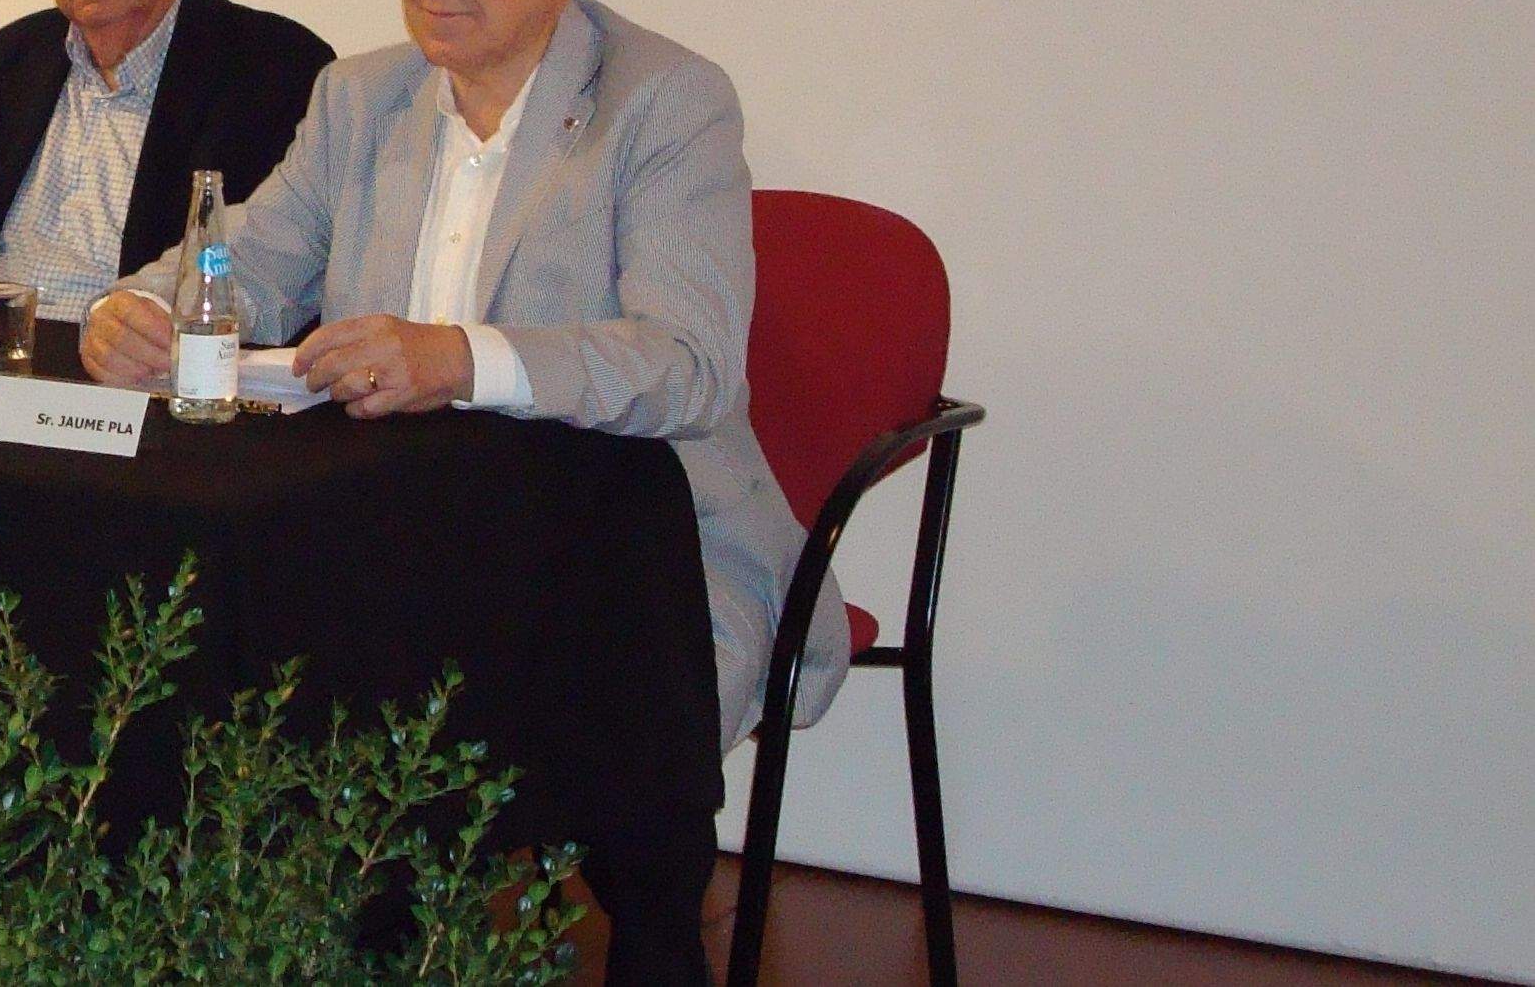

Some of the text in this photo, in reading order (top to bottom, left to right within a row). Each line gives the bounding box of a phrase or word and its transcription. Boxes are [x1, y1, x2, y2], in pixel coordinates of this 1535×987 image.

[36, 413, 133, 436] Sr. JAUME PLA
